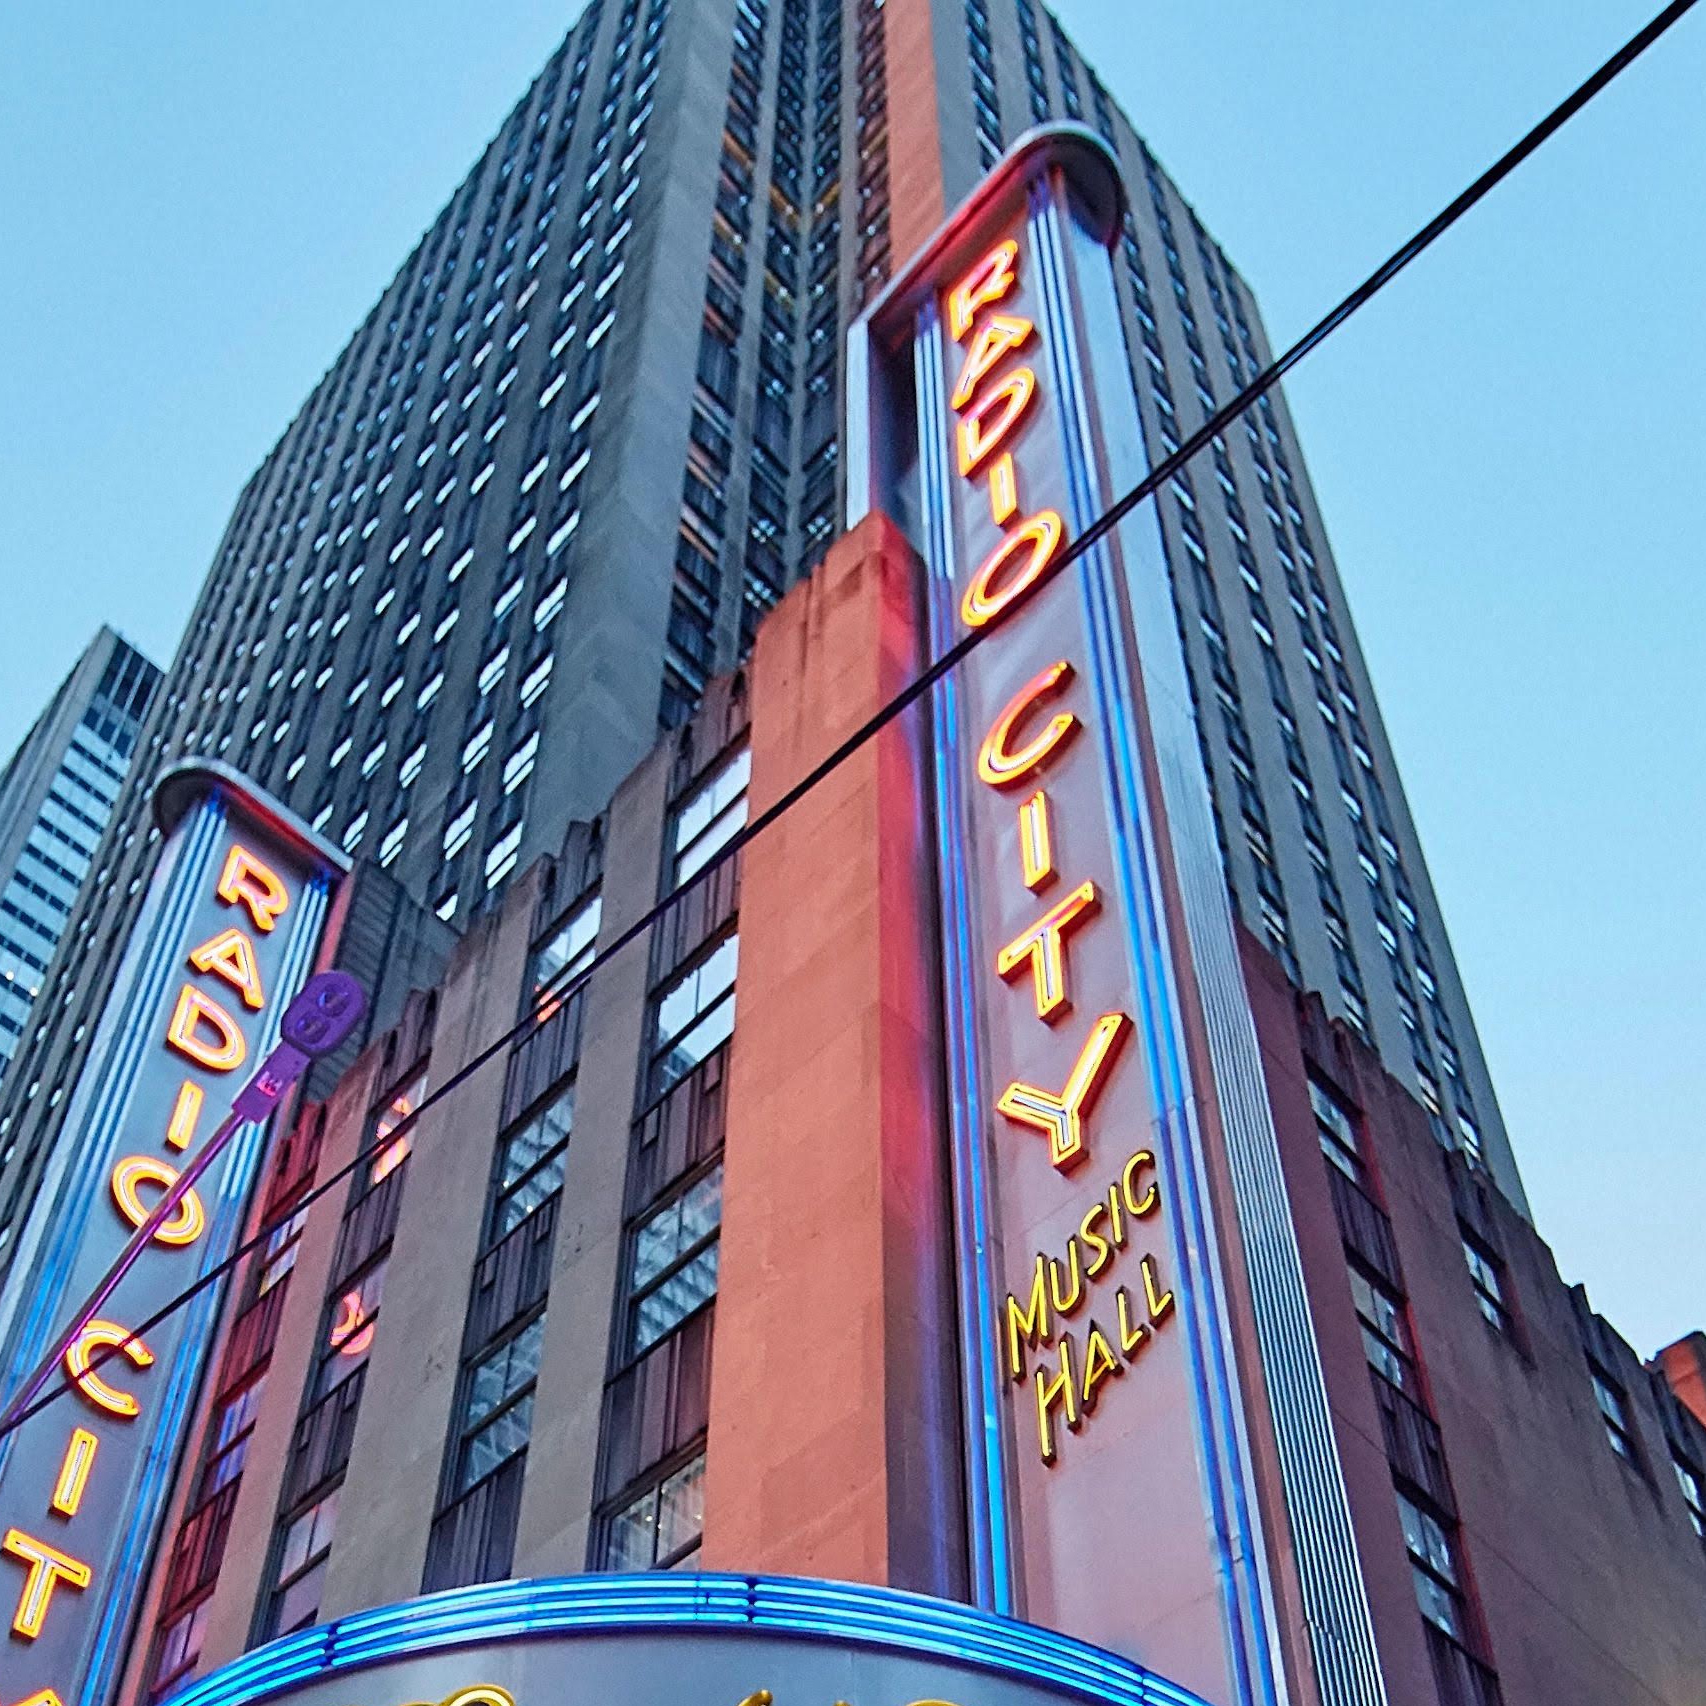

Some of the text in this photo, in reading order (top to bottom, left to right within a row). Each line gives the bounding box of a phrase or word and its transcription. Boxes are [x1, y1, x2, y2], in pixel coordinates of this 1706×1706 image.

[949, 239, 1131, 1174] RADIO CITY
[111, 844, 289, 1247] RADIO
[1005, 1150, 1157, 1380] MUSIC
[1034, 1260, 1173, 1465] HALL
